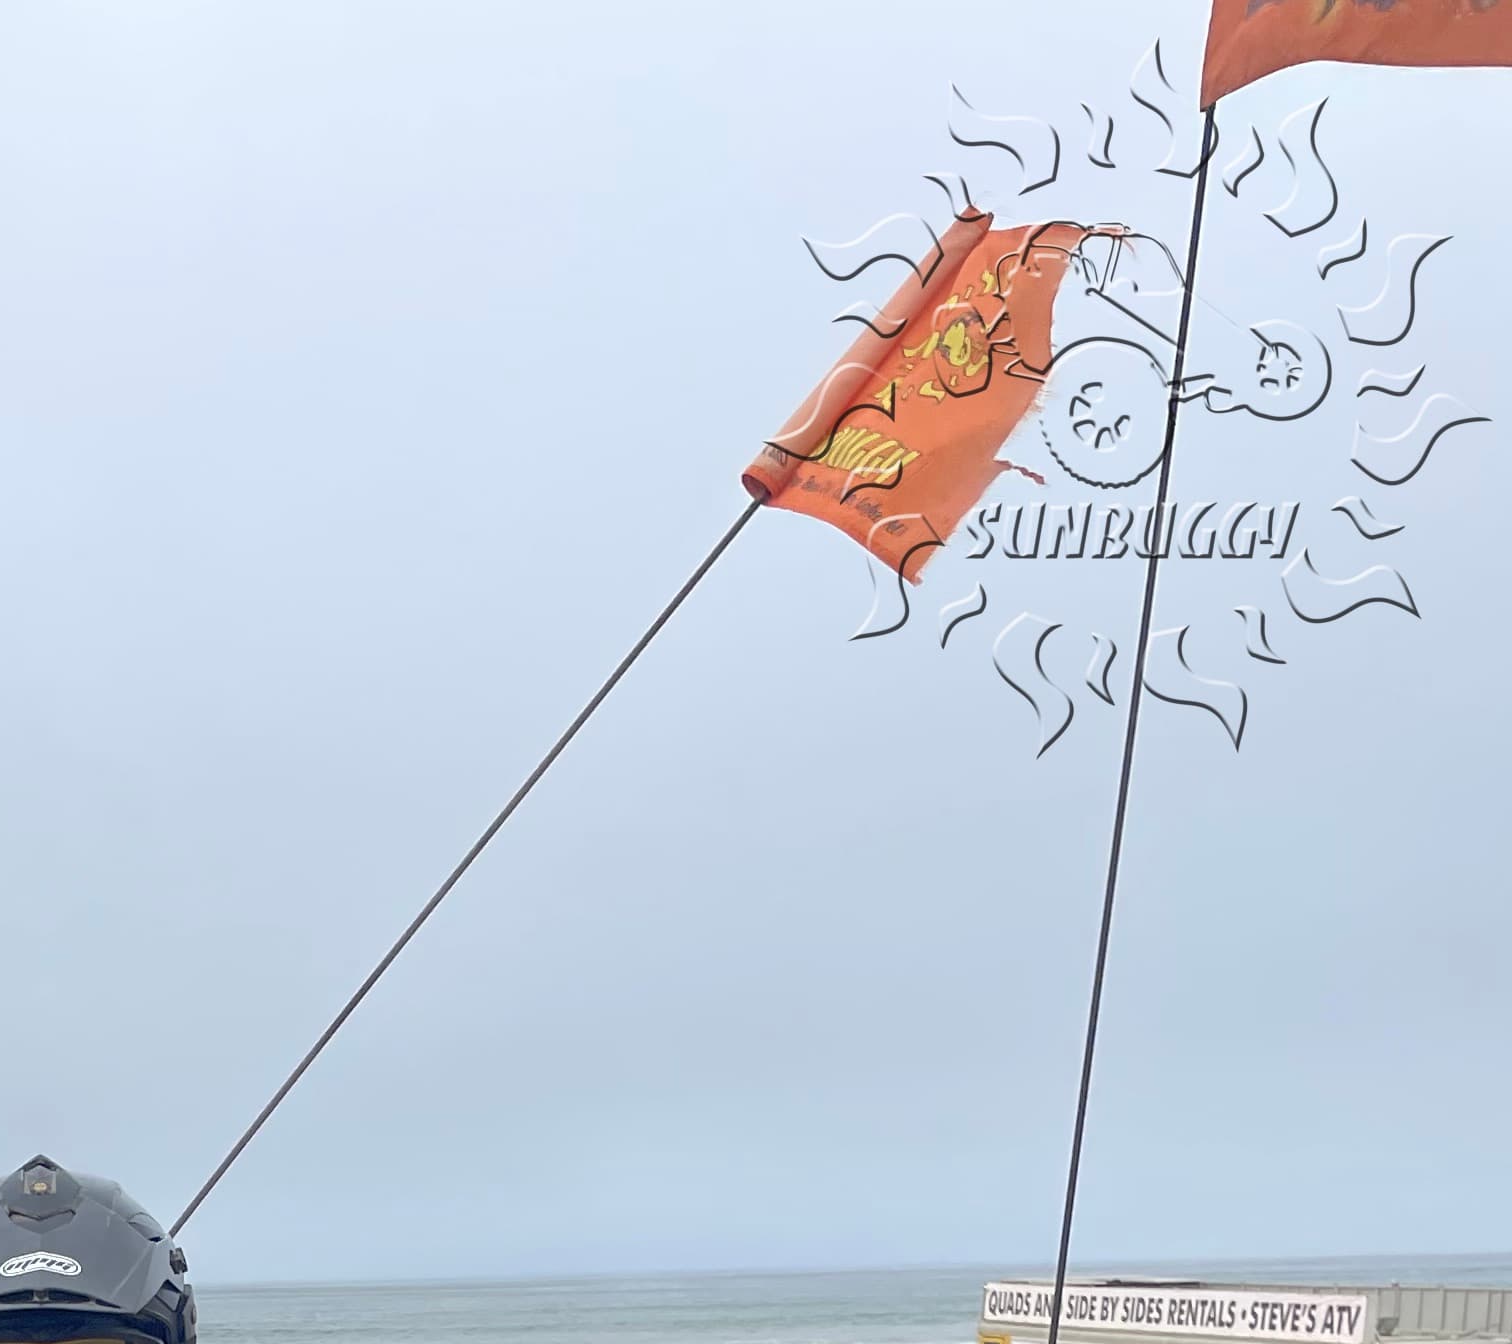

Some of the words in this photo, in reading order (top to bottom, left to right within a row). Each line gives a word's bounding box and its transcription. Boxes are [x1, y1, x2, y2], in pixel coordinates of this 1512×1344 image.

[988, 1290, 1032, 1317] QUADS
[1033, 1293, 1061, 1318] AN
[1066, 1295, 1097, 1321] SIDE
[1100, 1297, 1120, 1322] BY
[1121, 1297, 1164, 1324] SIDES
[1167, 1299, 1236, 1329] RENTALS
[1248, 1301, 1316, 1334] STEVE'S
[1320, 1304, 1361, 1336] ATV
